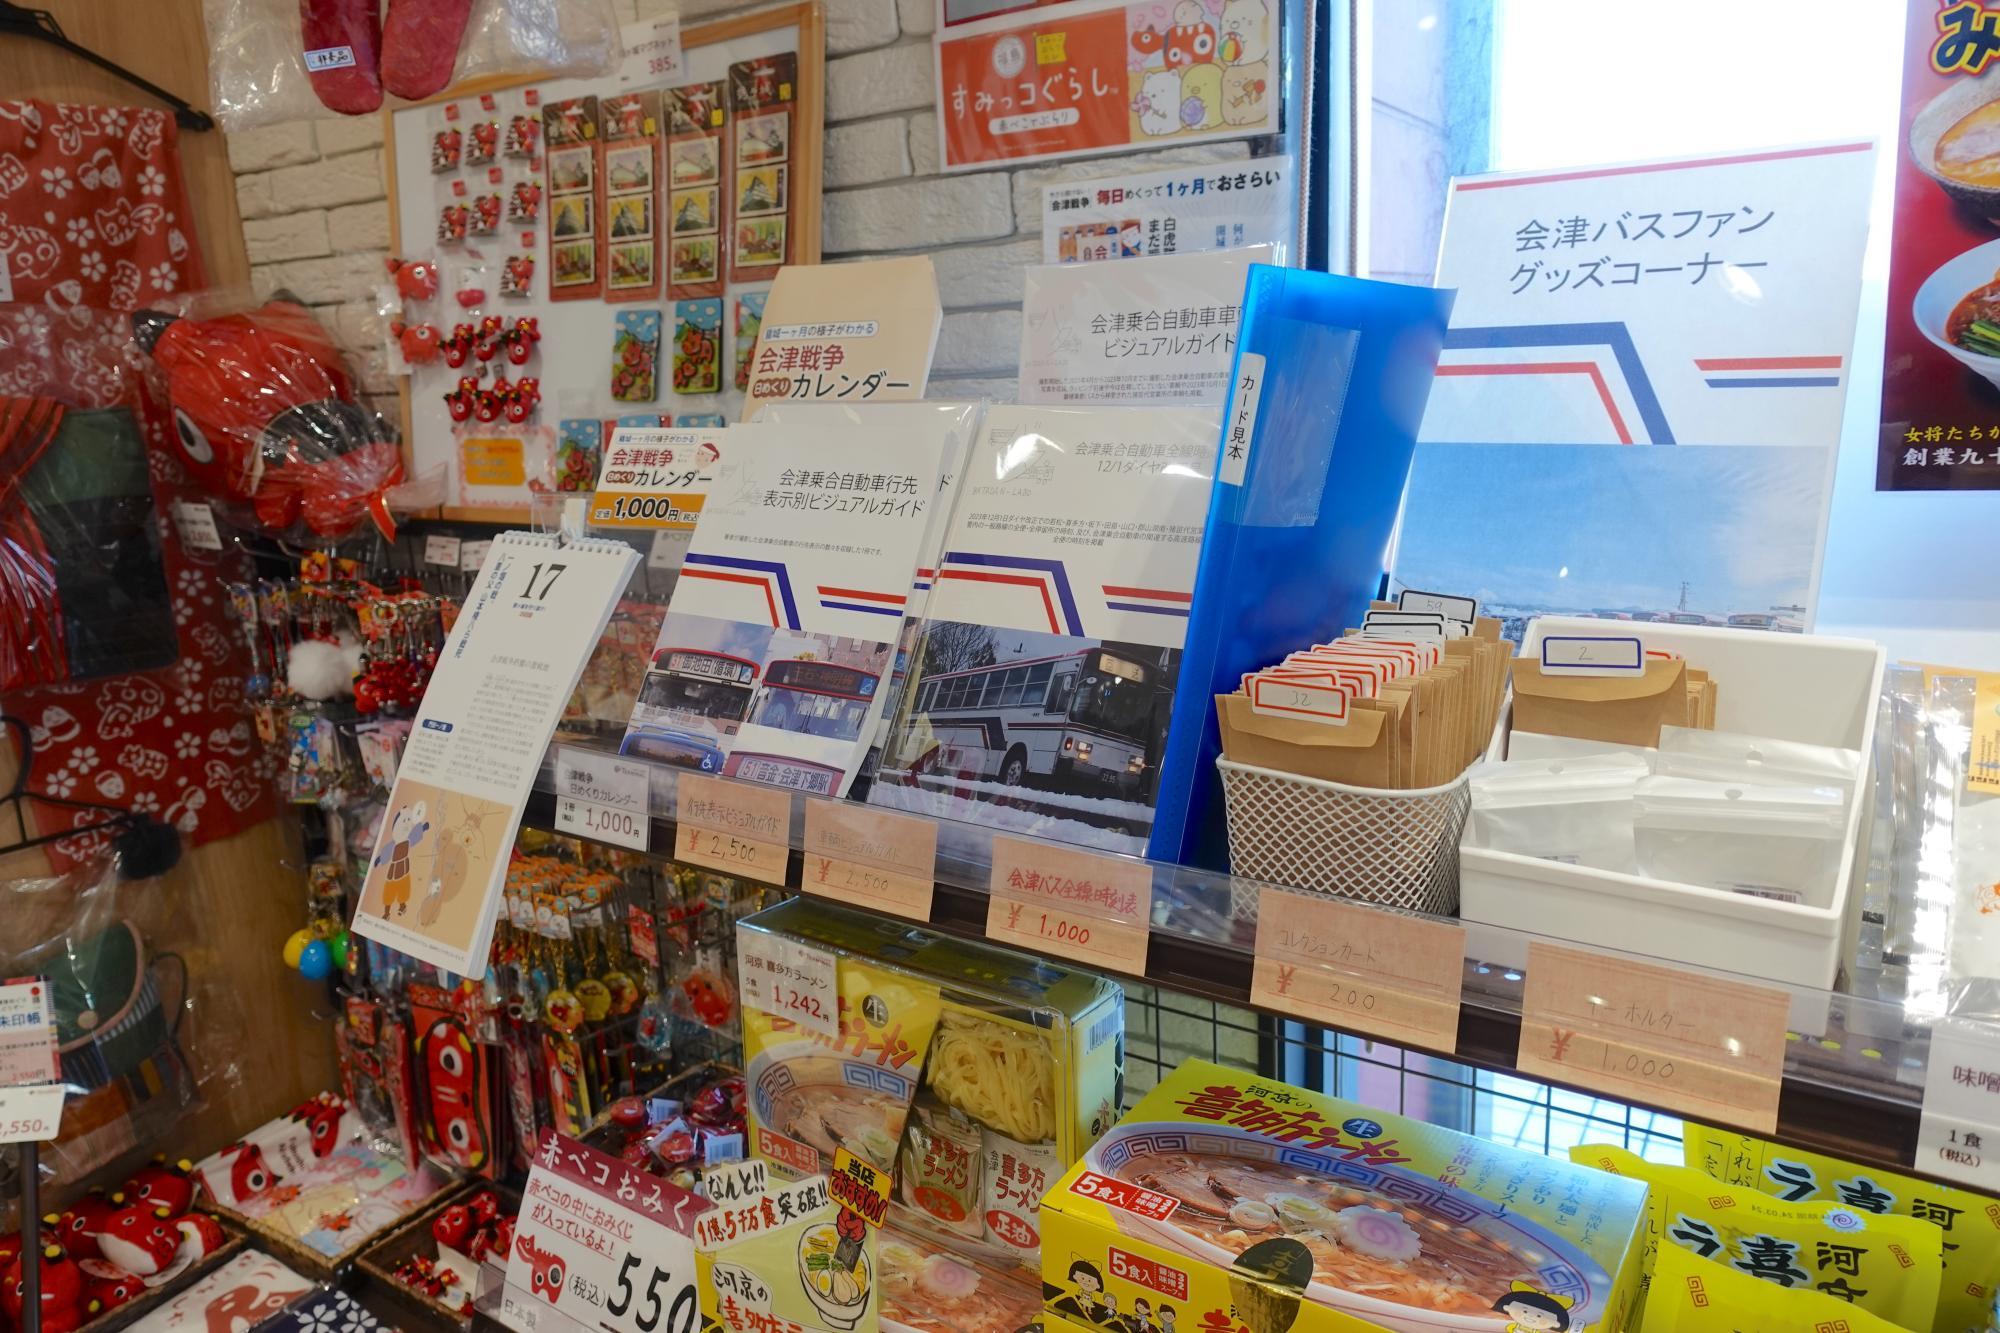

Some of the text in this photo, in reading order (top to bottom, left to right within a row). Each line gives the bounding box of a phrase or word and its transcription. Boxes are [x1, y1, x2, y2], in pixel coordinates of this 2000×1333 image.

[952, 68, 1109, 119] すみっコぐらし
[1515, 204, 1775, 252] 会津バスファン
[1509, 252, 1768, 295] グッズコーナー
[758, 344, 845, 374] 会津戦争
[1104, 332, 1236, 359] ビジュアルガイド
[754, 370, 910, 398] 日めくり カレンダー
[1227, 374, 1256, 461] カード見本
[611, 448, 673, 467] 会津戦争
[635, 470, 712, 487] カレンダー
[779, 468, 919, 495] 会津乗合自動車行先
[616, 498, 679, 521] 1,000円
[763, 489, 927, 518] 表示別ビジュアルガイド
[519, 562, 567, 601] 17
[586, 807, 640, 839] 1,000円
[710, 835, 756, 863] 2,500
[846, 870, 889, 892] 2,500
[1007, 867, 1139, 918] 会津バス全線時刻表
[1040, 914, 1090, 944] 1,000
[1279, 930, 1383, 964] コレクションカード
[766, 961, 828, 990] 喜多方ラーメン
[773, 985, 830, 1023] 1,242円
[864, 998, 886, 1027] 生
[1602, 1044, 1676, 1079] 1,000
[0, 1118, 50, 1136] ,550
[1175, 1085, 1412, 1166] 喜多方ラーメン
[1346, 1118, 1380, 1138] 生
[930, 1135, 970, 1170] 喜多方
[1939, 1147, 1981, 1167] (税込)
[540, 1133, 690, 1231] 赤ベコおみく
[708, 1162, 766, 1201] なんと!!
[847, 1158, 877, 1187] 当店
[923, 1154, 969, 1190] ラーメン
[1002, 1153, 1046, 1193] 喜多方
[831, 1168, 888, 1224] おすすめ!
[995, 1177, 1041, 1214] ラーメン
[1075, 1174, 1125, 1206] 5食入
[528, 1177, 634, 1241] 赤ベコの中におみくじ
[995, 1213, 1032, 1245] 正油
[714, 1263, 768, 1302] 河京の
[1112, 1251, 1153, 1284] 5食入
[568, 1273, 607, 1309] (税込)
[607, 1251, 698, 1333] 550
[504, 1298, 538, 1332] 日本製
